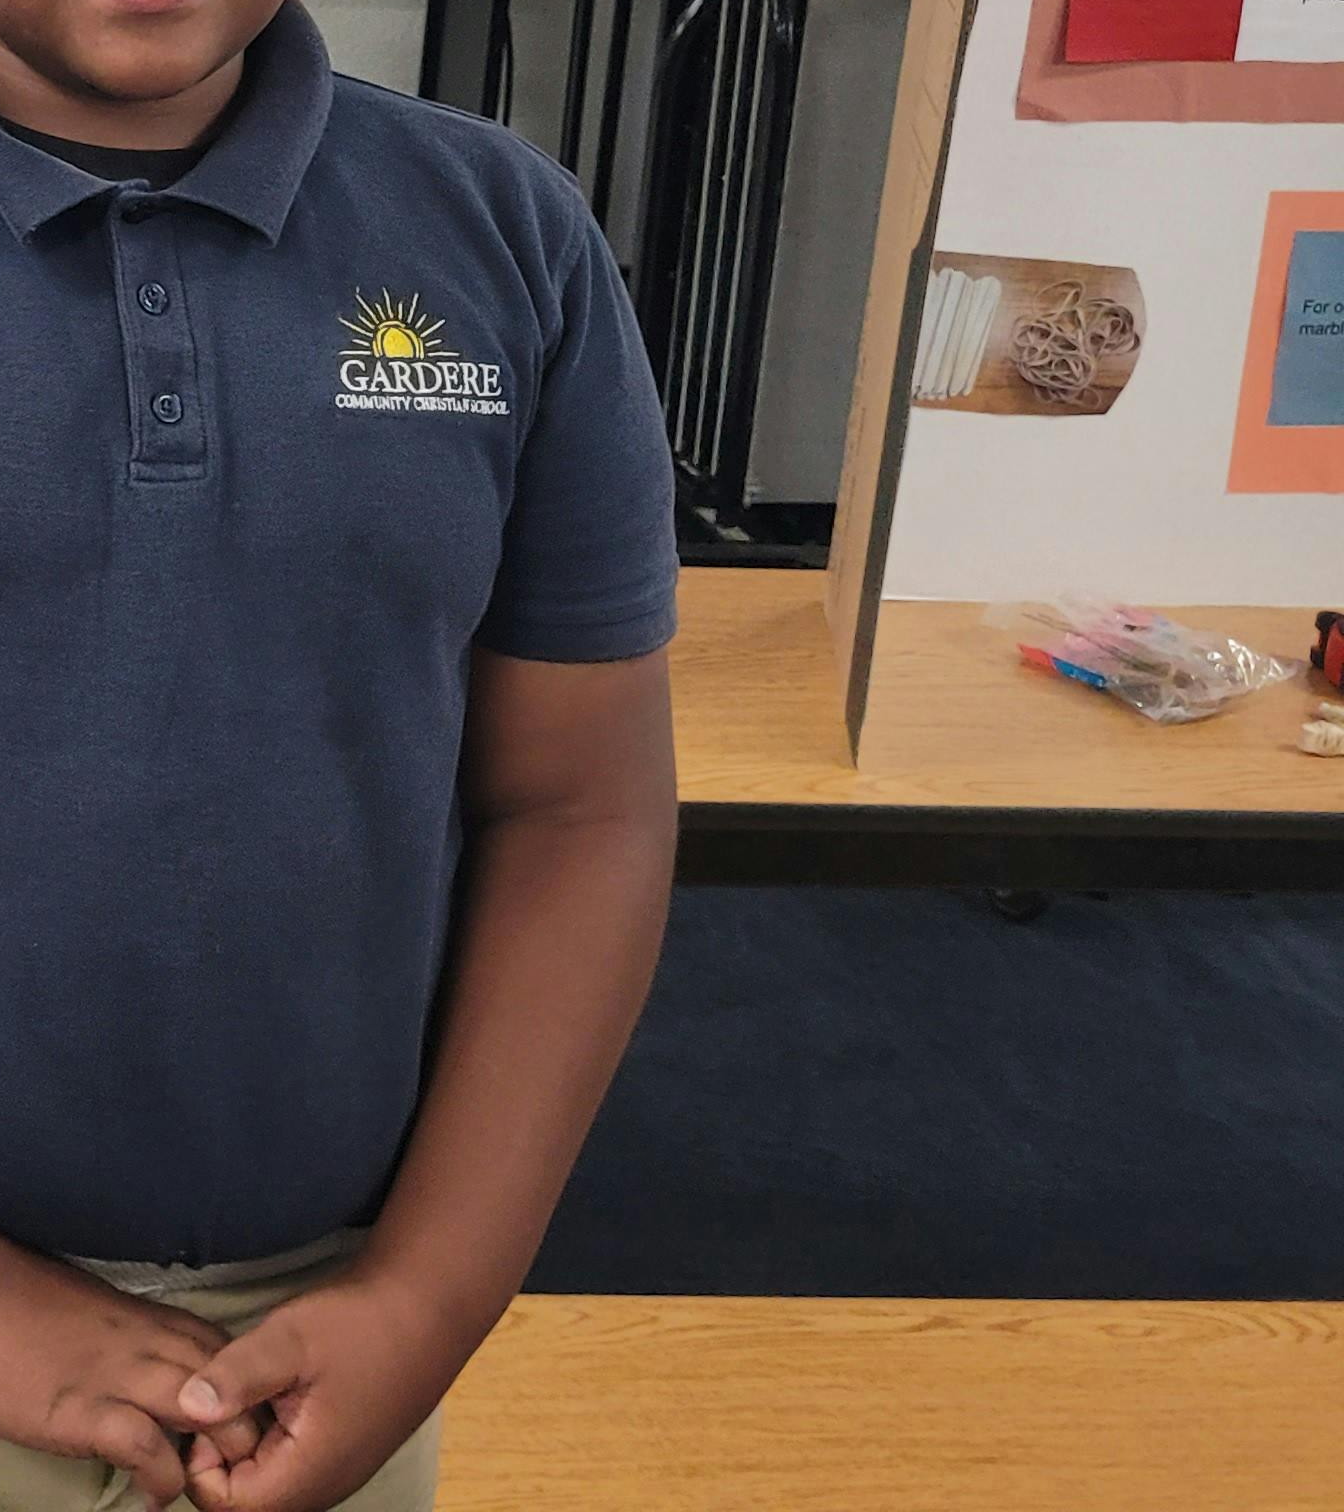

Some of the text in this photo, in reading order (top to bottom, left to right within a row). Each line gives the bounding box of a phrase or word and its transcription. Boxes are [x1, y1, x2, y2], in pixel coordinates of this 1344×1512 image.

[1303, 299, 1330, 314] For
[339, 359, 503, 397] GARDERE
[335, 393, 510, 416] COMMUNITY CHRISTIAN SCHOOL
